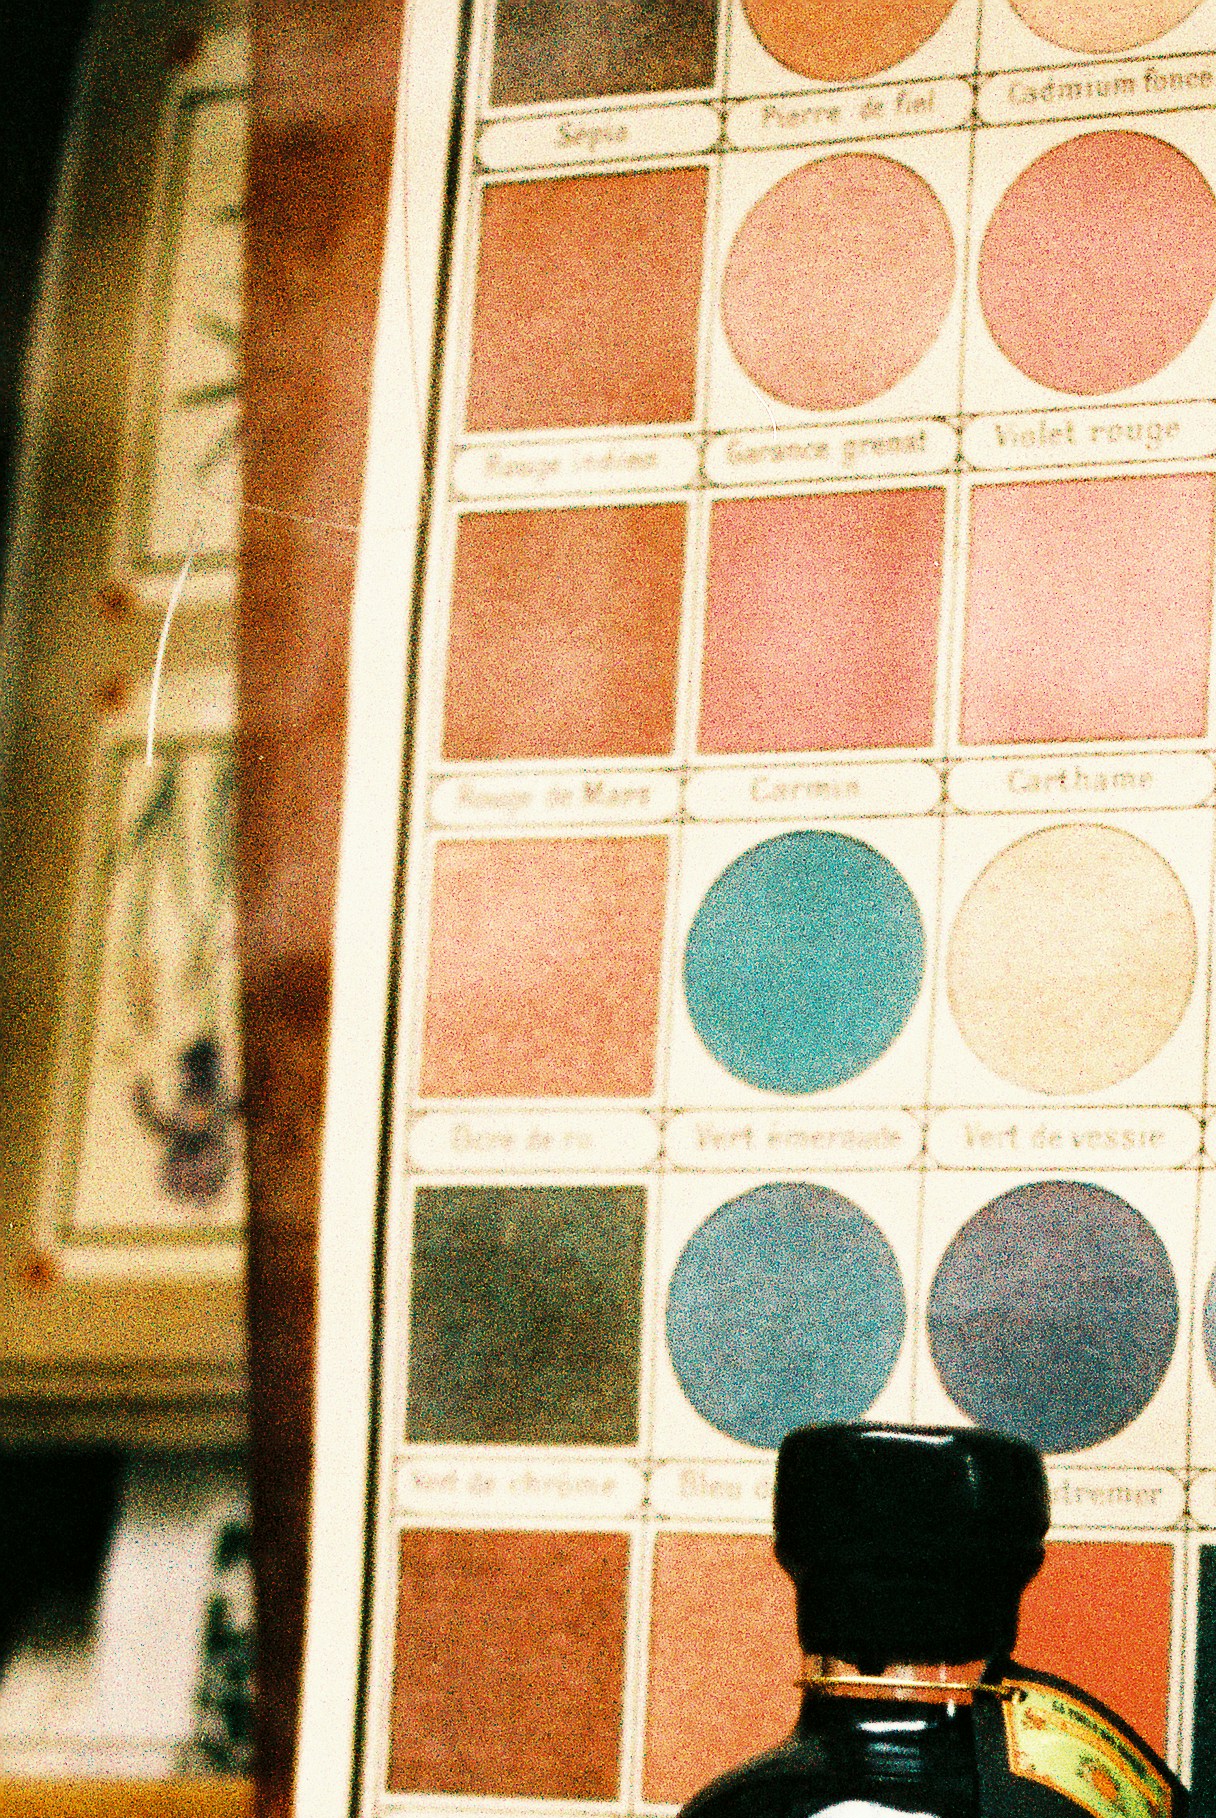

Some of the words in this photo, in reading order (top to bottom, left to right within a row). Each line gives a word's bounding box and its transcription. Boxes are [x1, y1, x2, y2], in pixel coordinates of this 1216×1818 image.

[1008, 75, 1135, 105] Cadmium
[995, 419, 1075, 448] Violet
[1089, 415, 1181, 450] rouge
[1006, 764, 1154, 794] Carthame
[962, 1119, 1018, 1149] Vert
[1030, 1119, 1063, 1147] de
